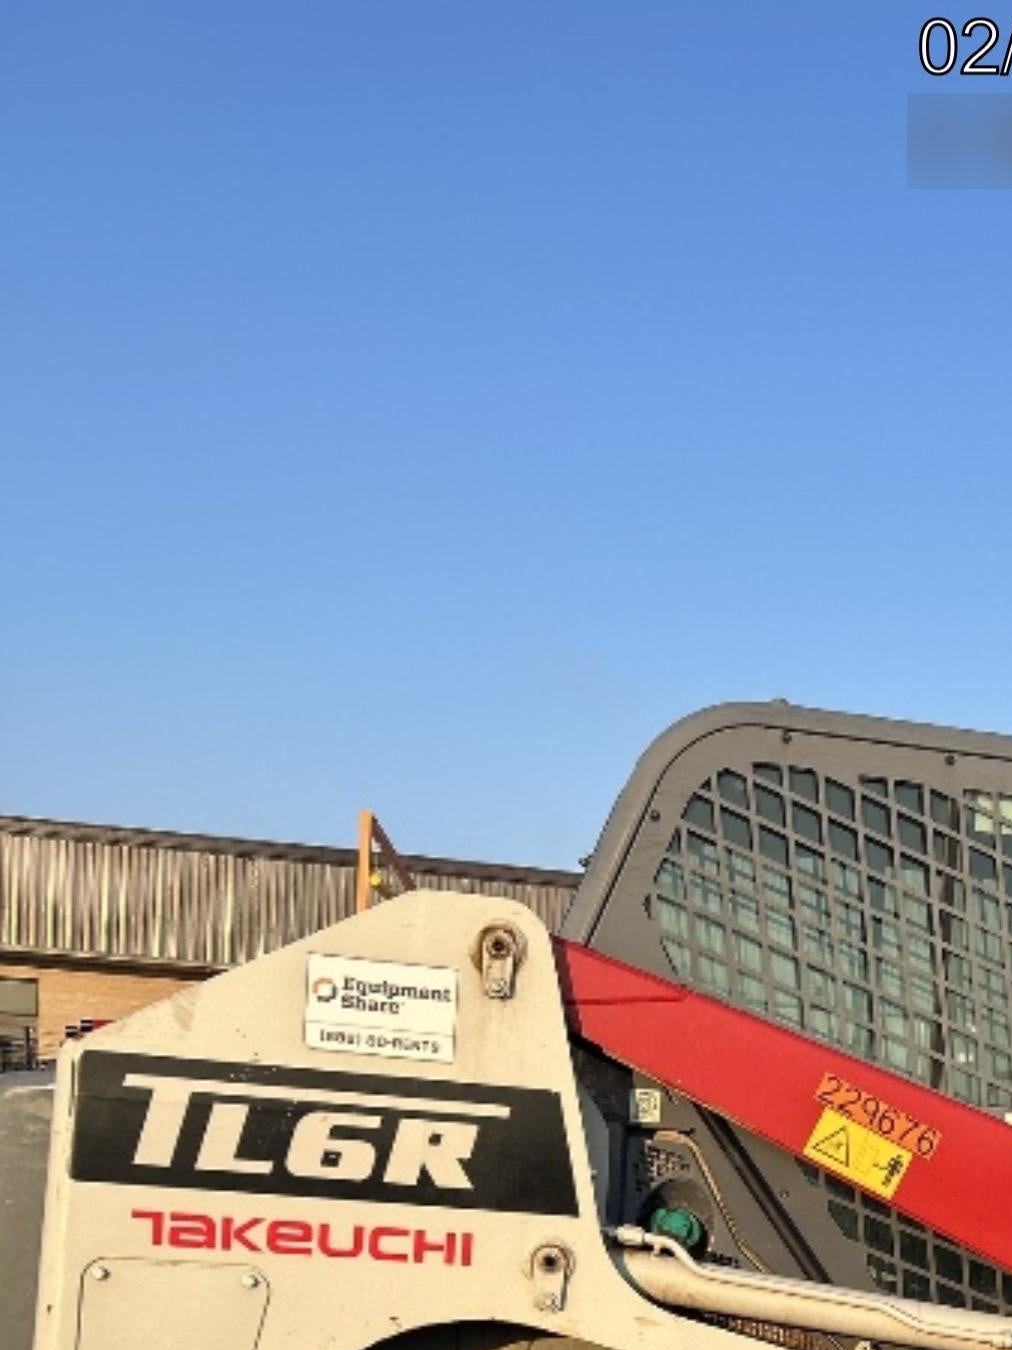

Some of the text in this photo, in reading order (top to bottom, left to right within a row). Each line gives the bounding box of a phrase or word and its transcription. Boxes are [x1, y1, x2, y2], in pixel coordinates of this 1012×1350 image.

[341, 976, 452, 1003] Equipment
[341, 993, 401, 1015] Share
[122, 1073, 511, 1189] TL6R
[818, 1076, 935, 1156] 229676
